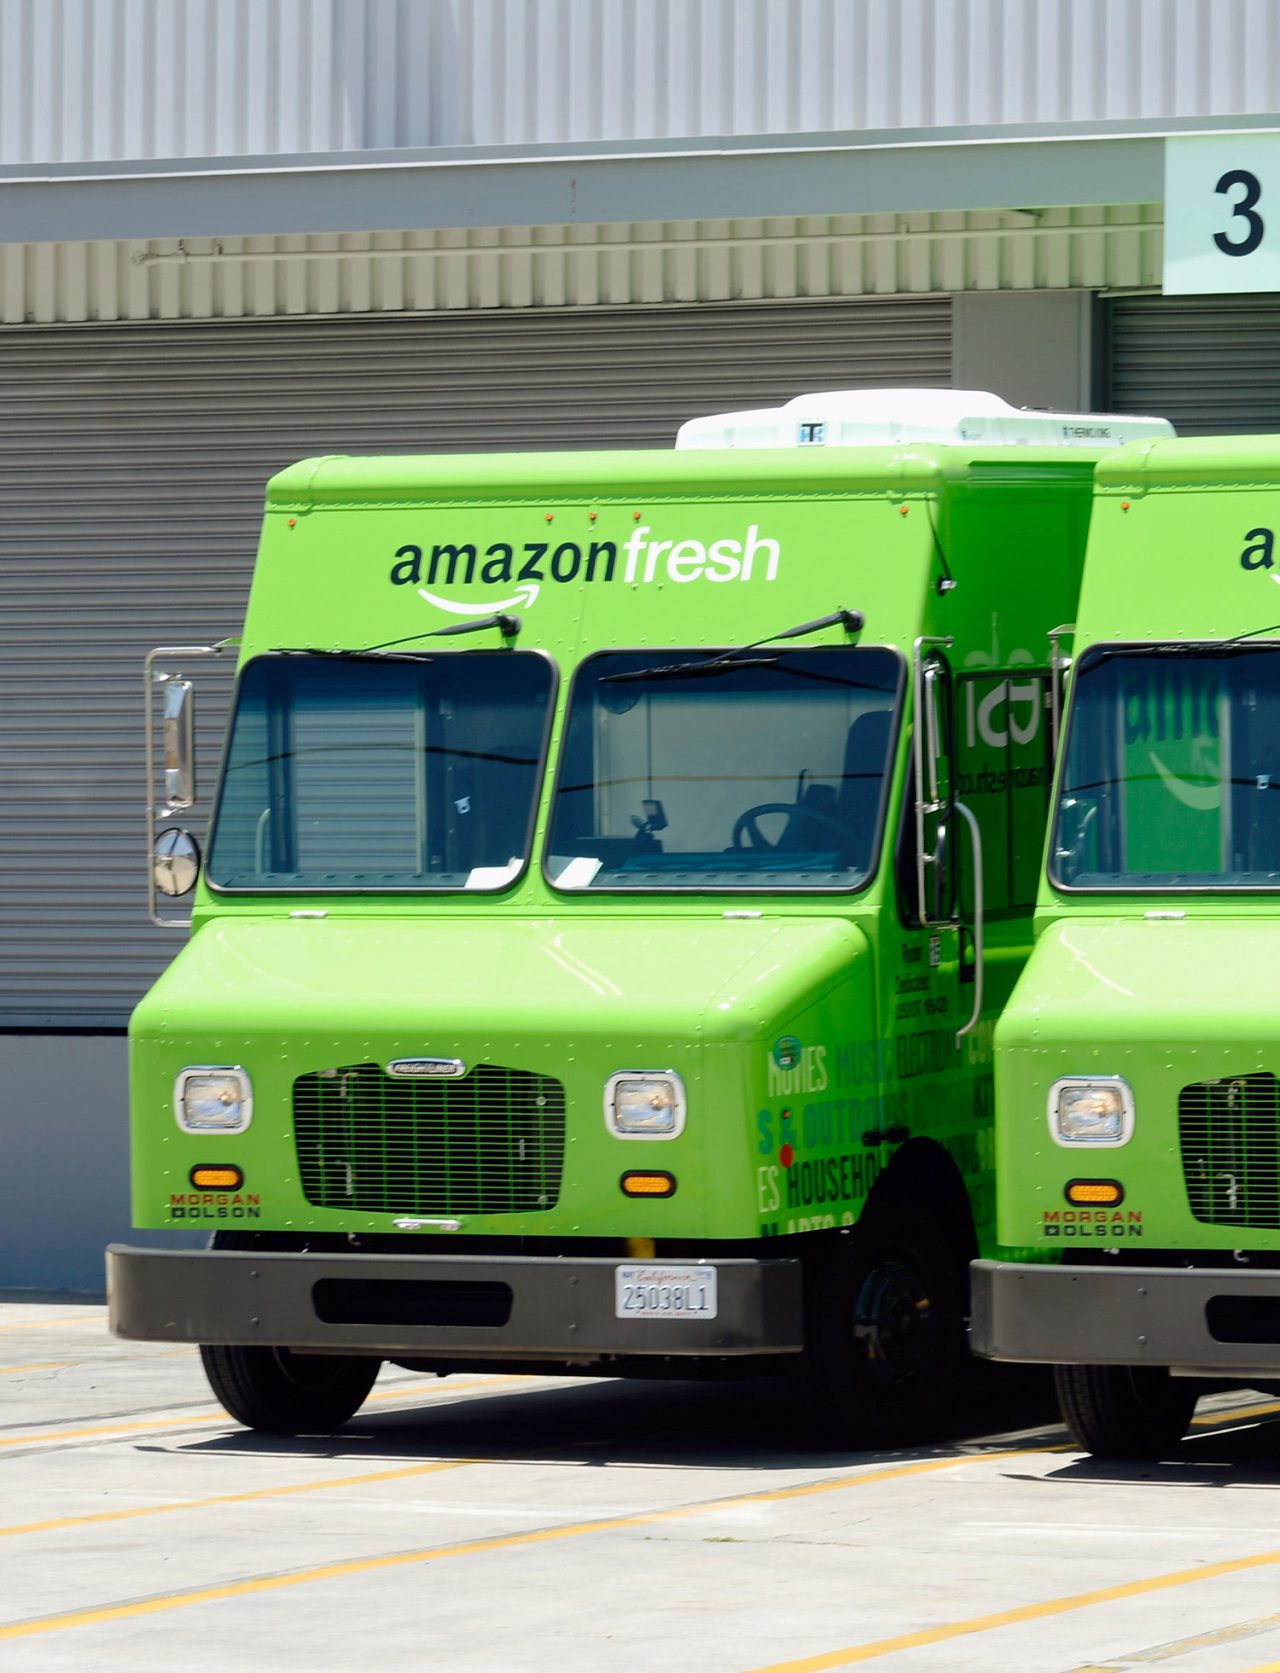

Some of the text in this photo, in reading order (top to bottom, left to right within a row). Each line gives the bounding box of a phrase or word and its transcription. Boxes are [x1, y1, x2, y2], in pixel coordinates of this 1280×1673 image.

[1211, 169, 1264, 256] 3
[390, 526, 781, 585] amazonfresh
[170, 1194, 261, 1205] MORGAN
[1043, 1211, 1142, 1222] MORGAN
[623, 1284, 710, 1310] 25038L1
